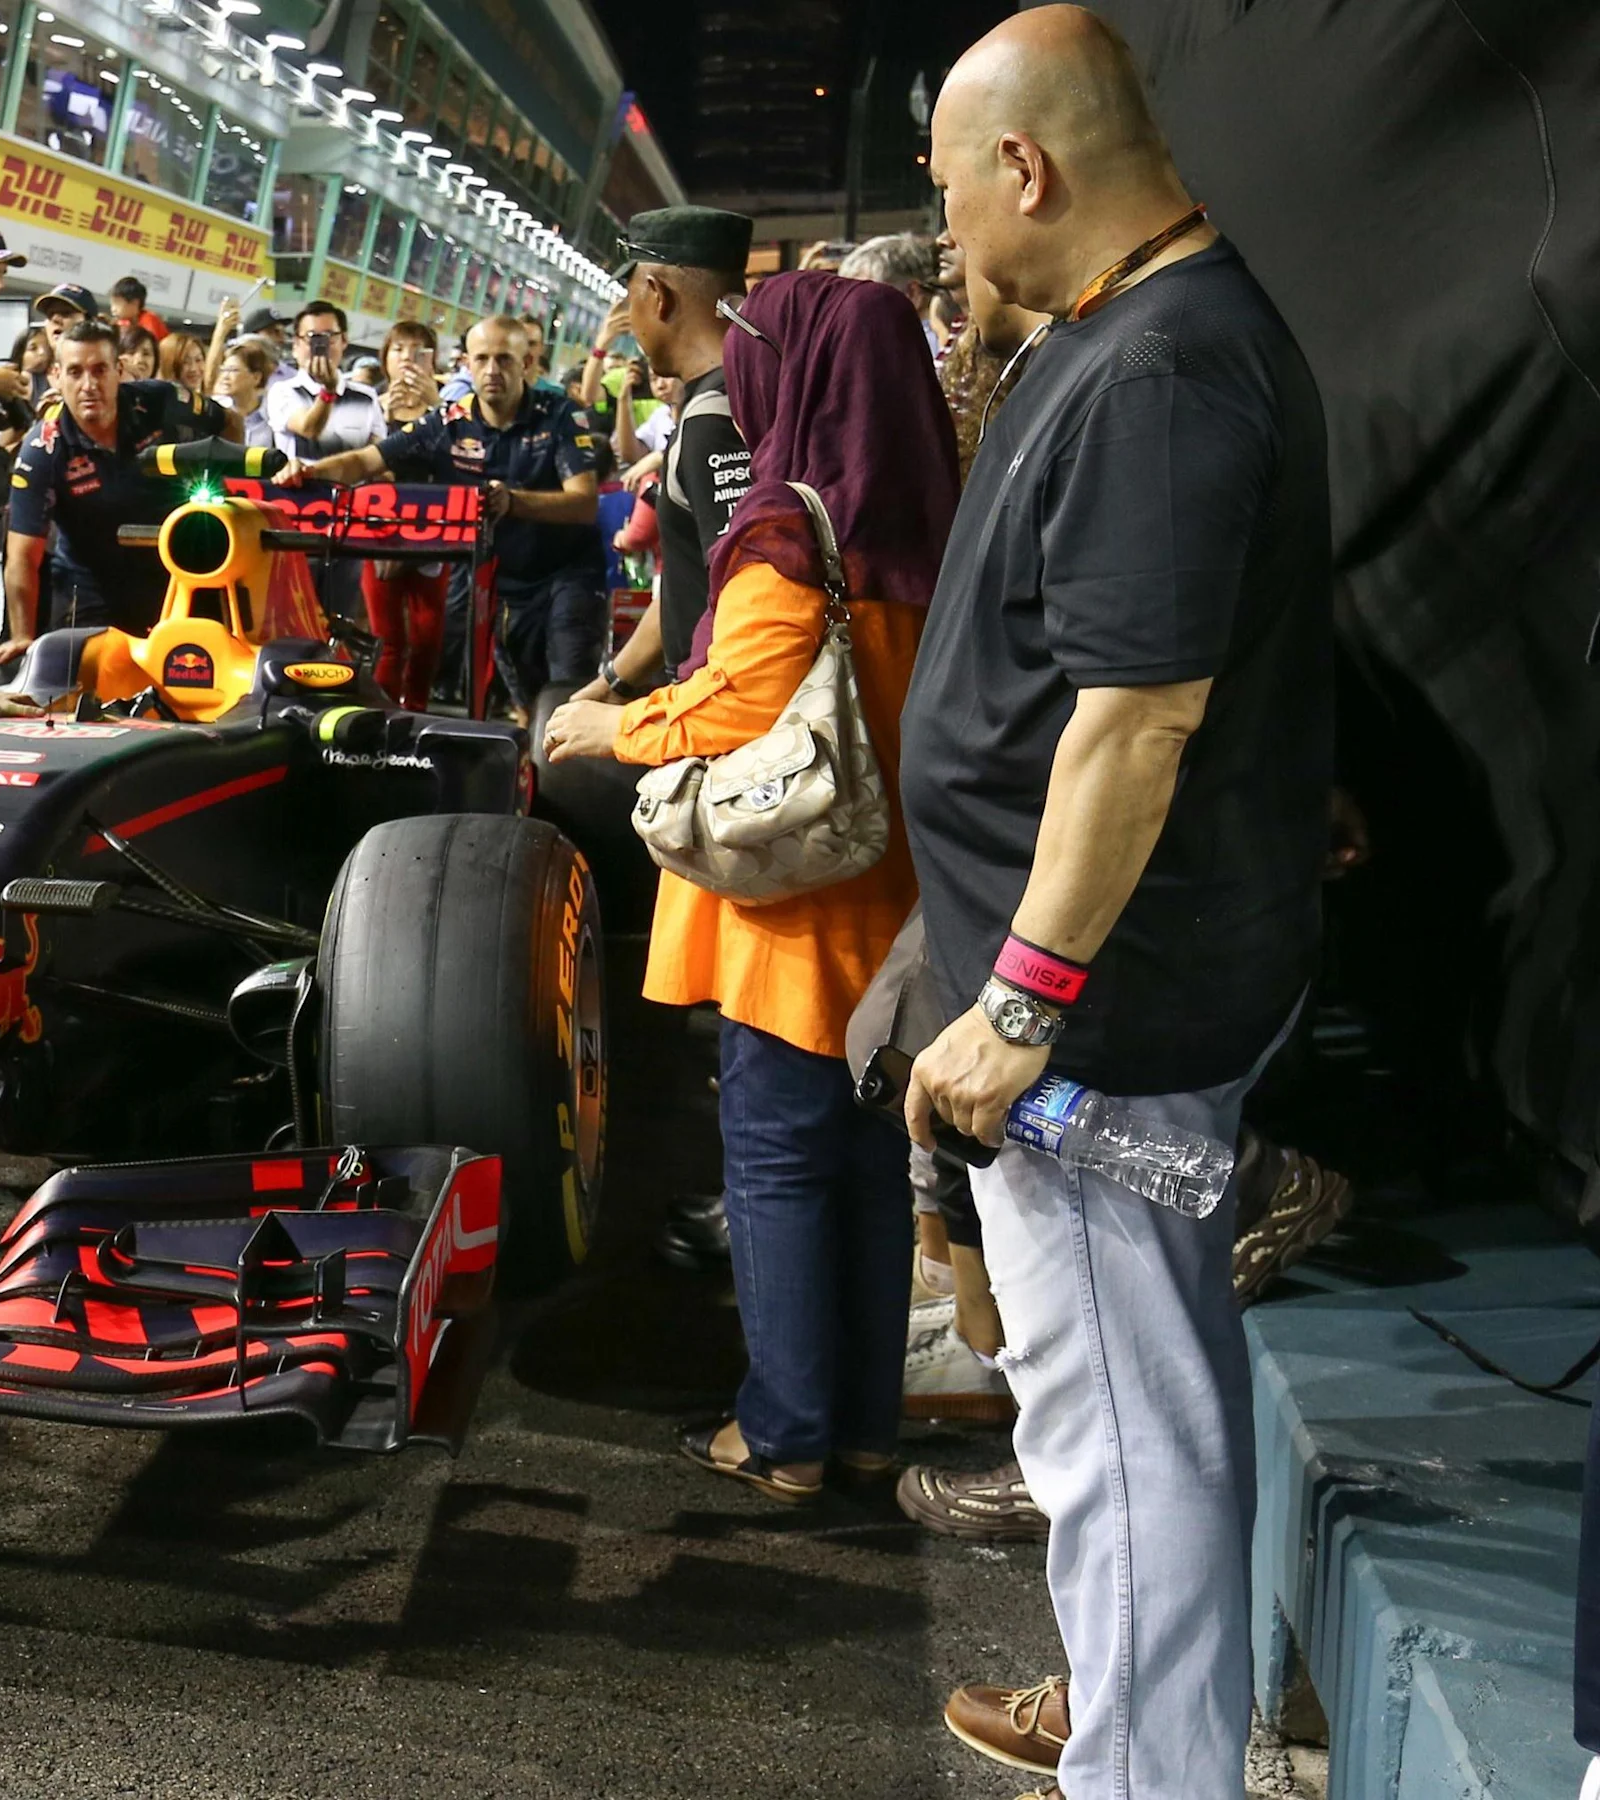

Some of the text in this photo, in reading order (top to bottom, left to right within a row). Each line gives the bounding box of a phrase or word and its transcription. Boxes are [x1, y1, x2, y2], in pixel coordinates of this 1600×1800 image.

[91, 187, 145, 245] DHL
[164, 211, 209, 262] DHL
[222, 232, 260, 276] DHL
[707, 451, 752, 469] QUALCO
[713, 466, 751, 486] EPS
[349, 482, 478, 542] Bull
[713, 487, 753, 503] Allian
[168, 666, 211, 680] Red Bull
[303, 668, 345, 679] RAUCH
[556, 864, 584, 1070] ZERO
[999, 950, 1072, 993] #SING
[411, 1192, 498, 1357] TOTAL
